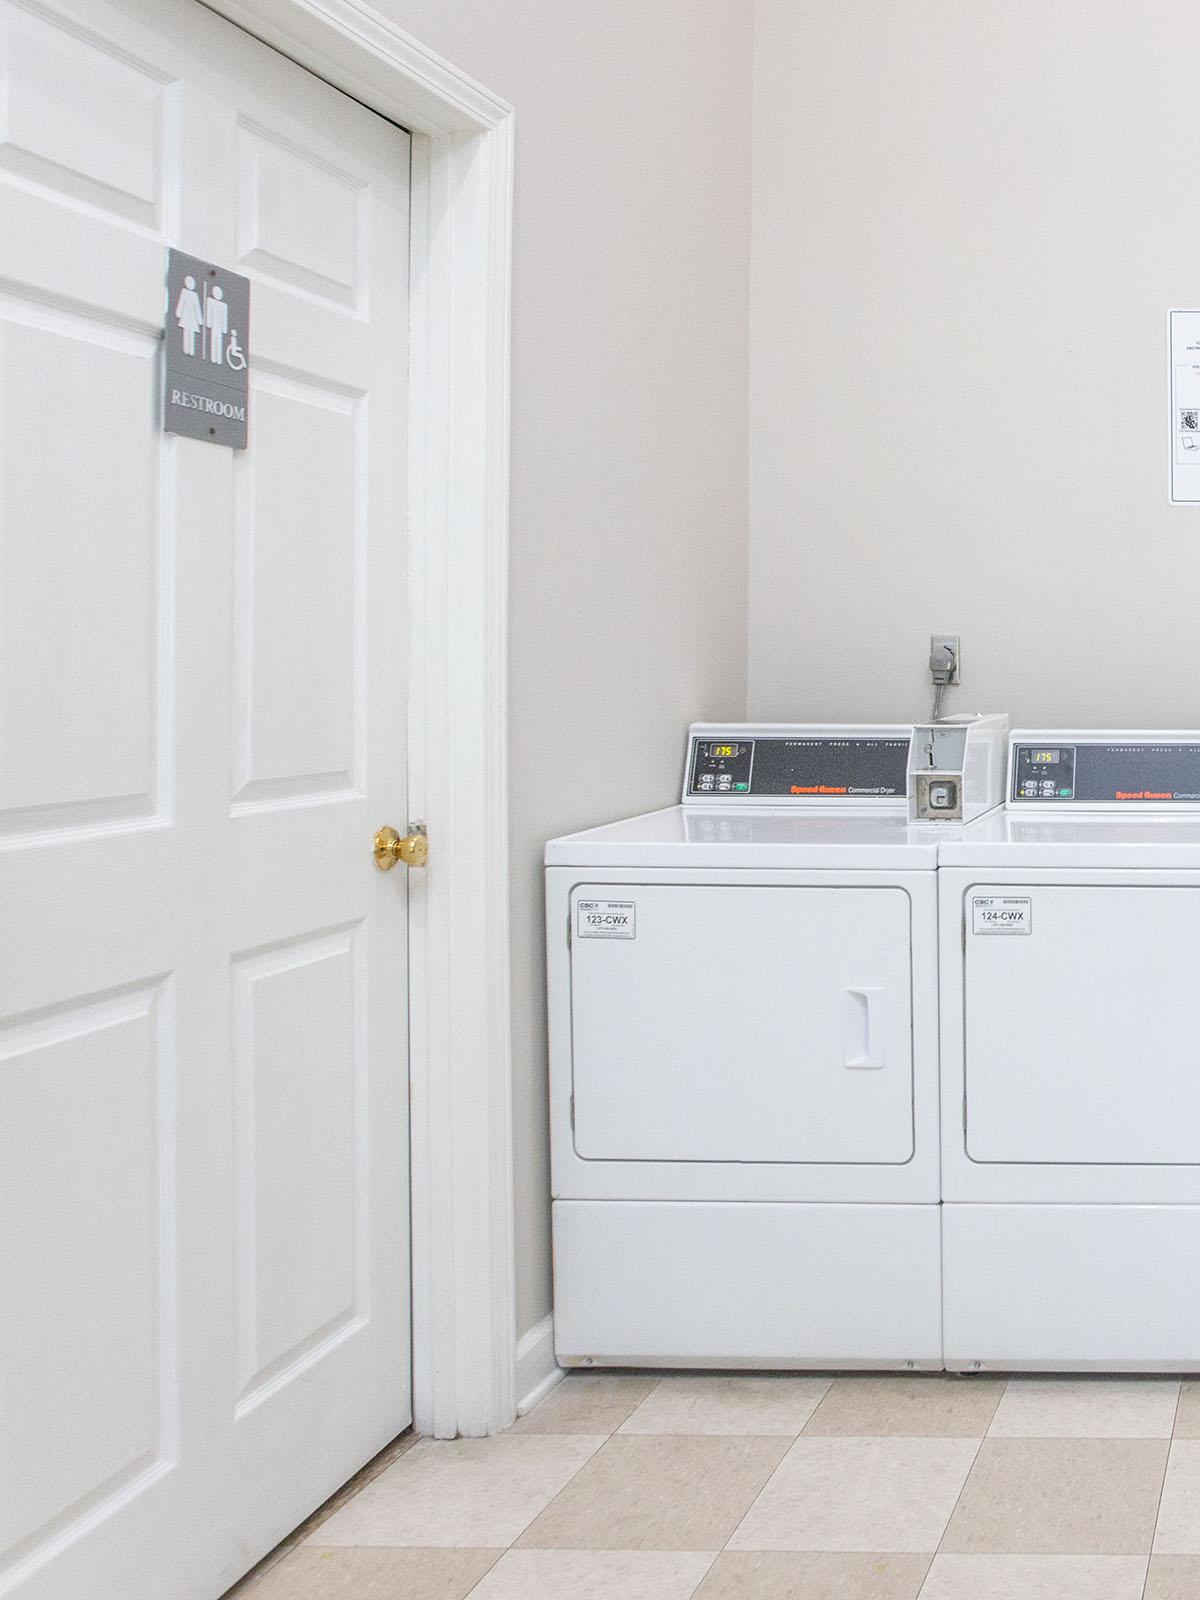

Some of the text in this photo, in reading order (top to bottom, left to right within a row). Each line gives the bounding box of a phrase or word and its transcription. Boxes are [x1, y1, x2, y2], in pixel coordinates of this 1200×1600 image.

[170, 389, 246, 422] RESTROOM
[716, 746, 732, 755] 175
[1036, 753, 1052, 762] 175
[790, 786, 818, 794] Speed
[1115, 791, 1143, 800] Speed
[586, 915, 628, 924] 123-CWX
[982, 912, 1024, 920] 124-CWX
